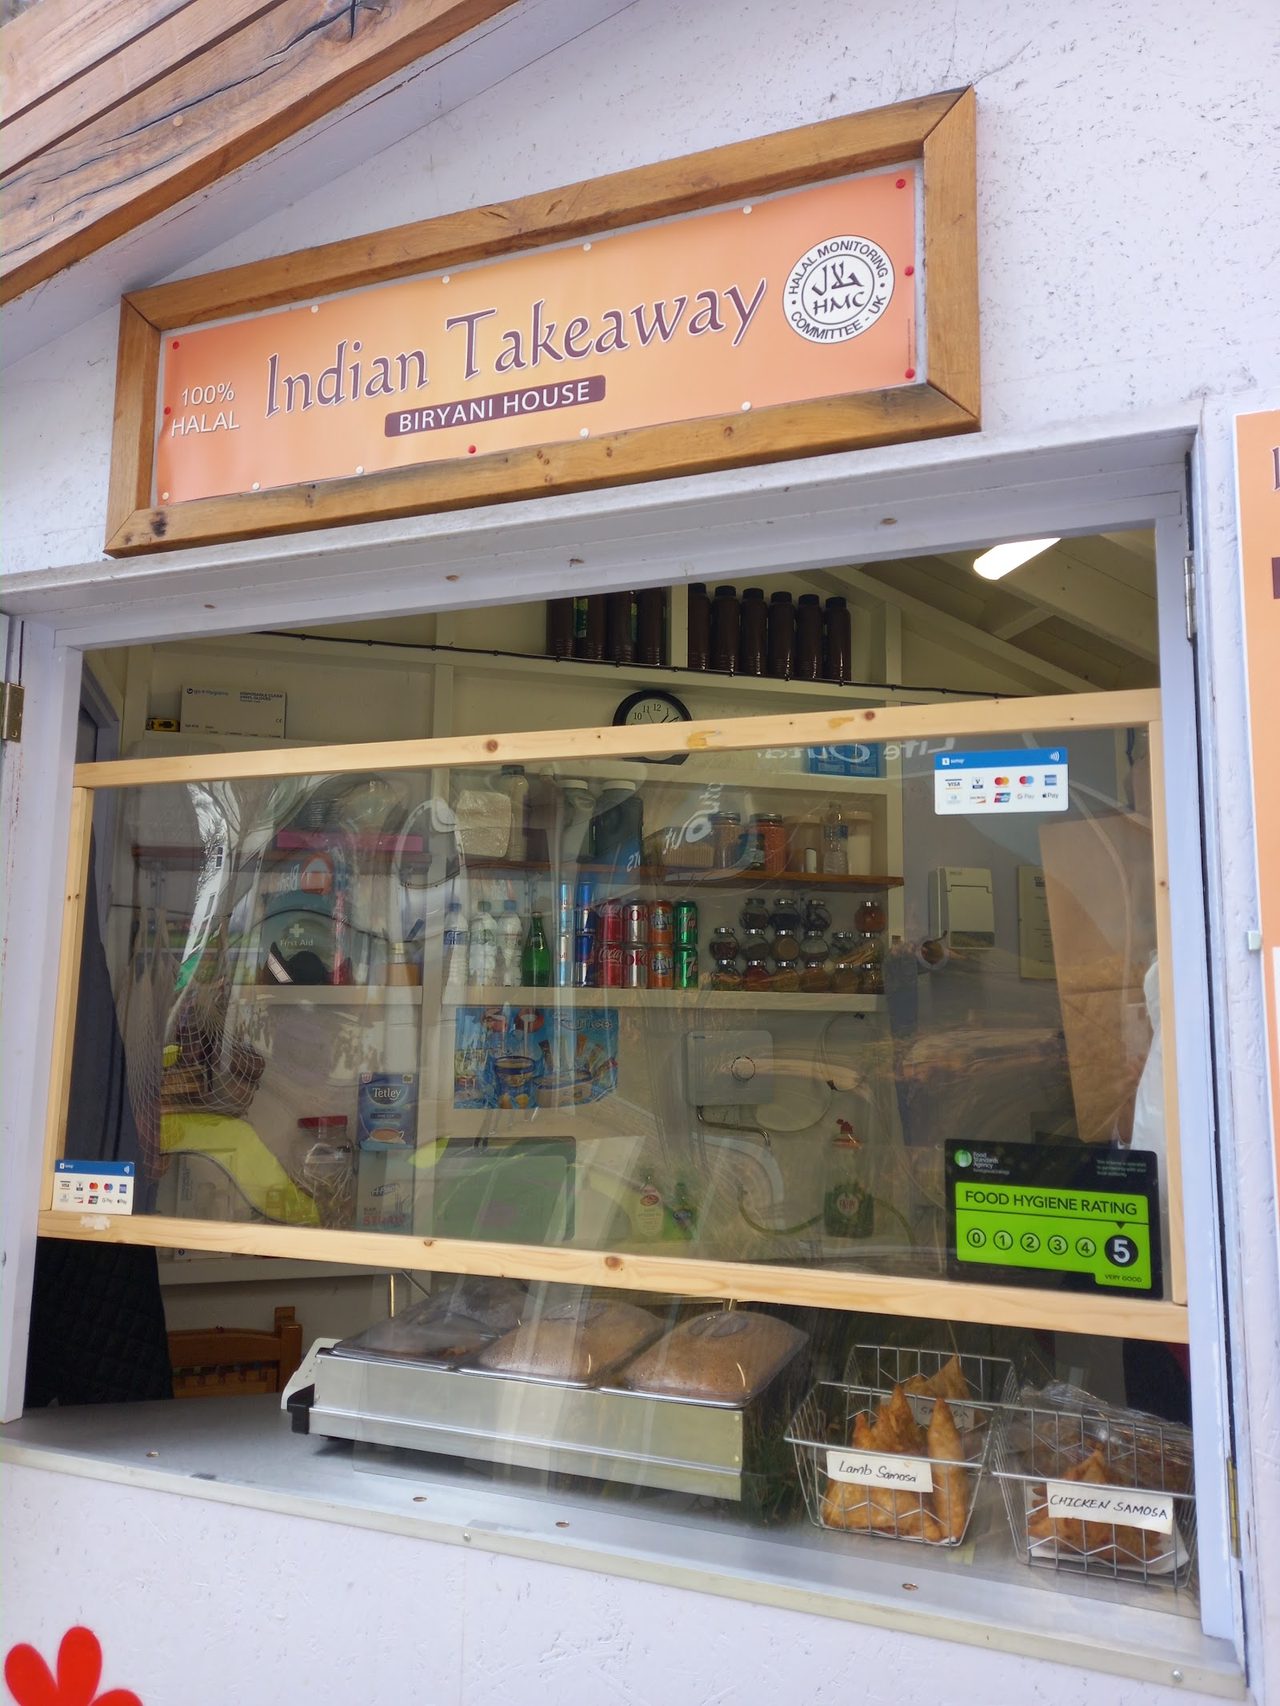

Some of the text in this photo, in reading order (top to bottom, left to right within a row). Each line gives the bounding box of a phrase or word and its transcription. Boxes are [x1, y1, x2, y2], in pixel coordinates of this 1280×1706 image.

[789, 240, 888, 294] HALAL MONITORING
[813, 291, 865, 315] HMC
[791, 311, 863, 339] COMMITTEE
[868, 295, 887, 315] UK
[265, 278, 767, 418] Indian Takeaway
[181, 381, 235, 407] 100%
[399, 381, 590, 433] BIRYANI HOUSE
[171, 410, 240, 437] HALAL
[634, 712, 643, 720] 10
[653, 704, 662, 712] 12
[299, 938, 314, 946] Aid
[372, 1087, 402, 1101] Tetley
[965, 1190, 1137, 1215] FOOD HYGIENE RATING
[972, 1232, 1130, 1264] 0 1 2 3 4 5
[1104, 1273, 1142, 1283] VERY GOOD
[839, 1460, 918, 1483] Lamb Samosa
[1049, 1493, 1169, 1519] CHICKEN SAMOSA
